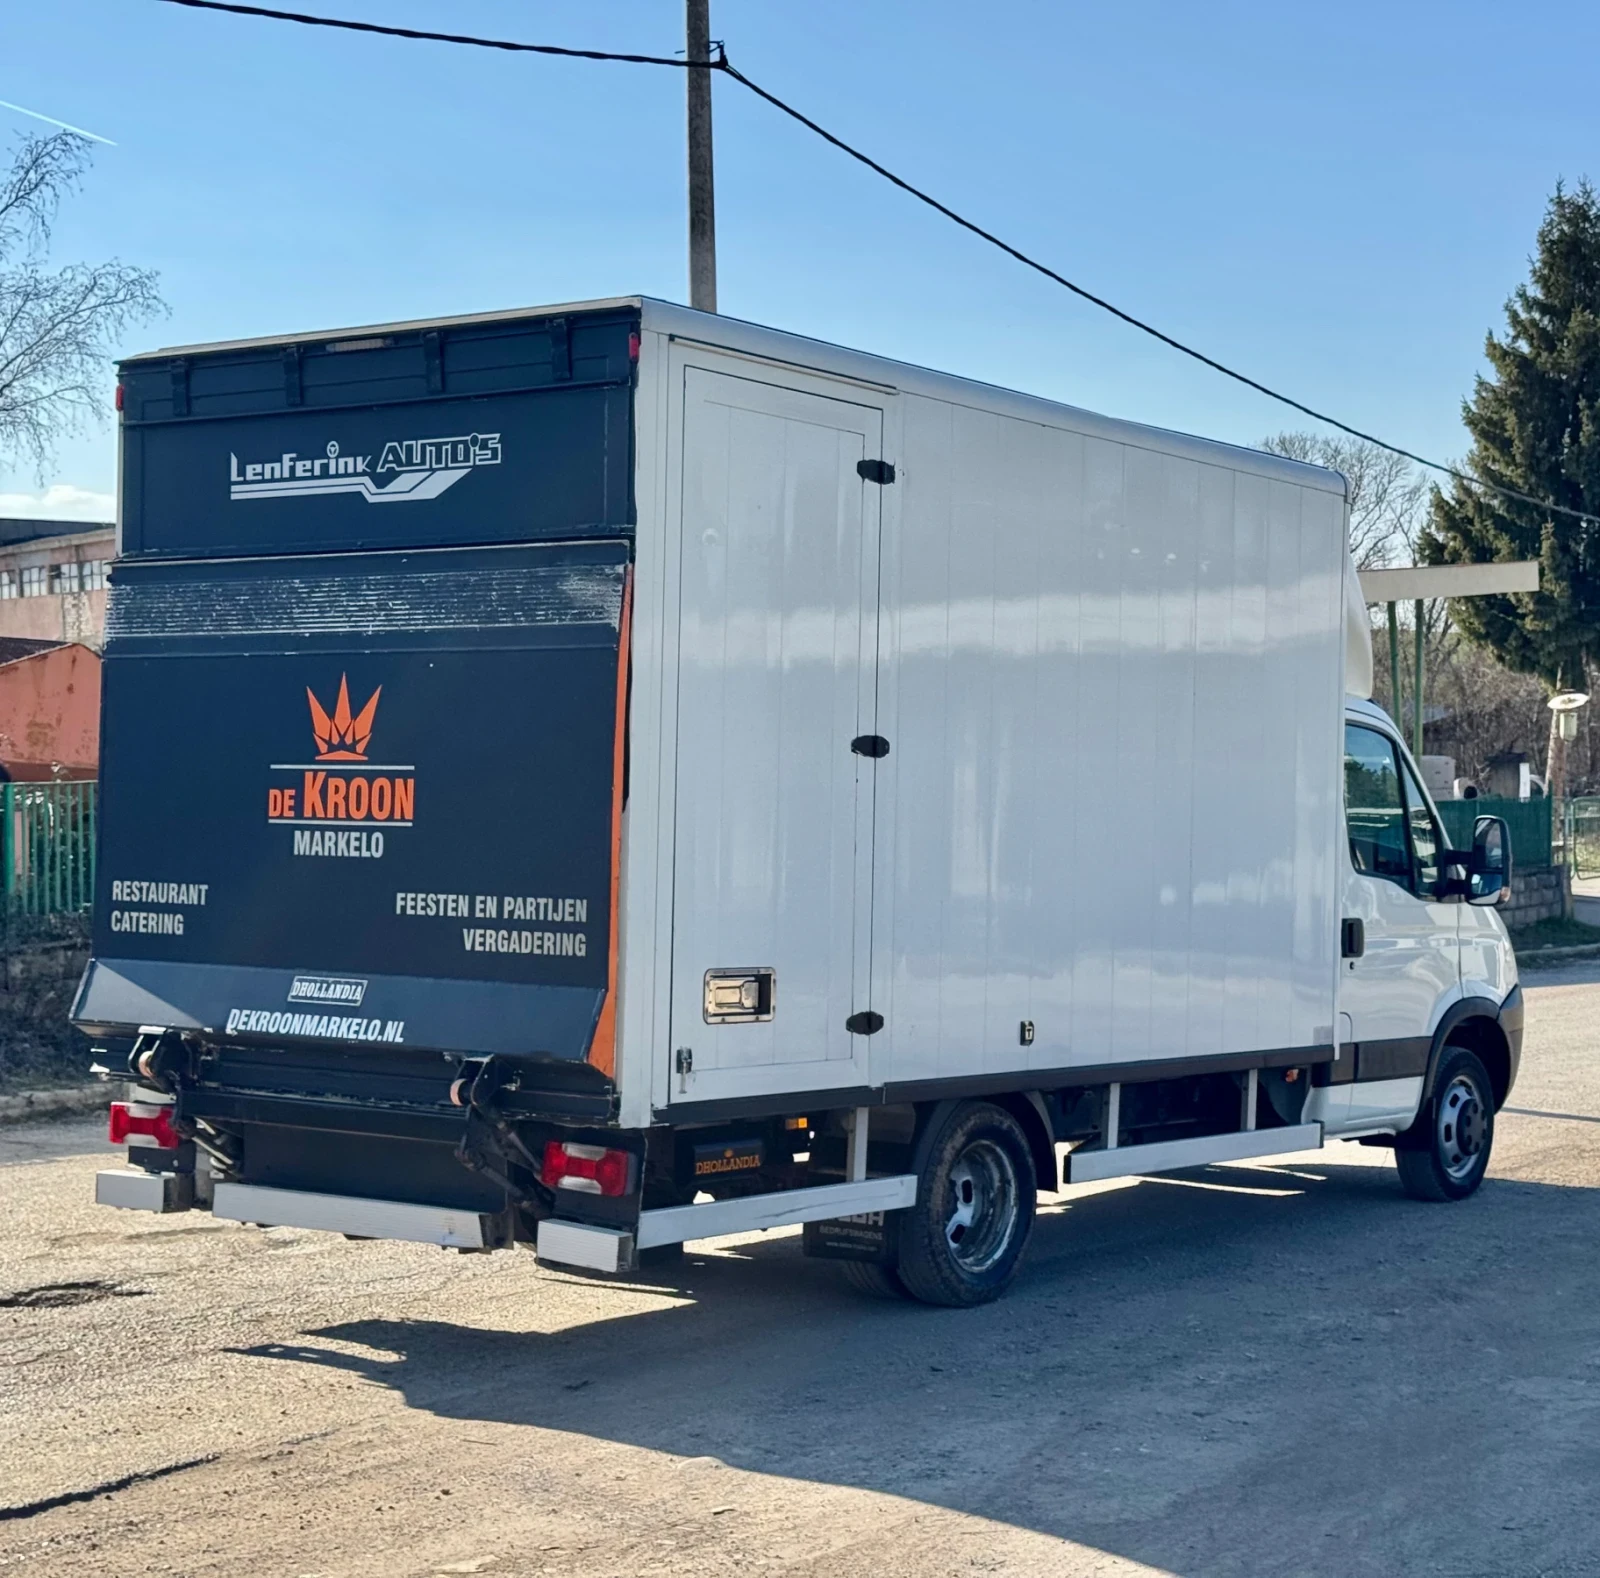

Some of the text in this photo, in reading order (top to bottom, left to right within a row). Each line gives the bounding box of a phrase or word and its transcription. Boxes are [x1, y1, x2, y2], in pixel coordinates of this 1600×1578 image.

[230, 433, 501, 482] Lenferink AUTO'S
[268, 771, 415, 821] DE KROON
[293, 830, 384, 859] MARKELO
[112, 880, 209, 905] RESTAURANT
[395, 892, 588, 922] FEESTEN EN PARTIJEN
[110, 910, 184, 935] CATERING
[462, 928, 587, 957] VERGADERING
[290, 980, 363, 1000] DHOLLANDIA
[225, 1008, 405, 1043] DEKROONMARKELO.NL
[695, 1155, 761, 1175] DHOLLANDIA
